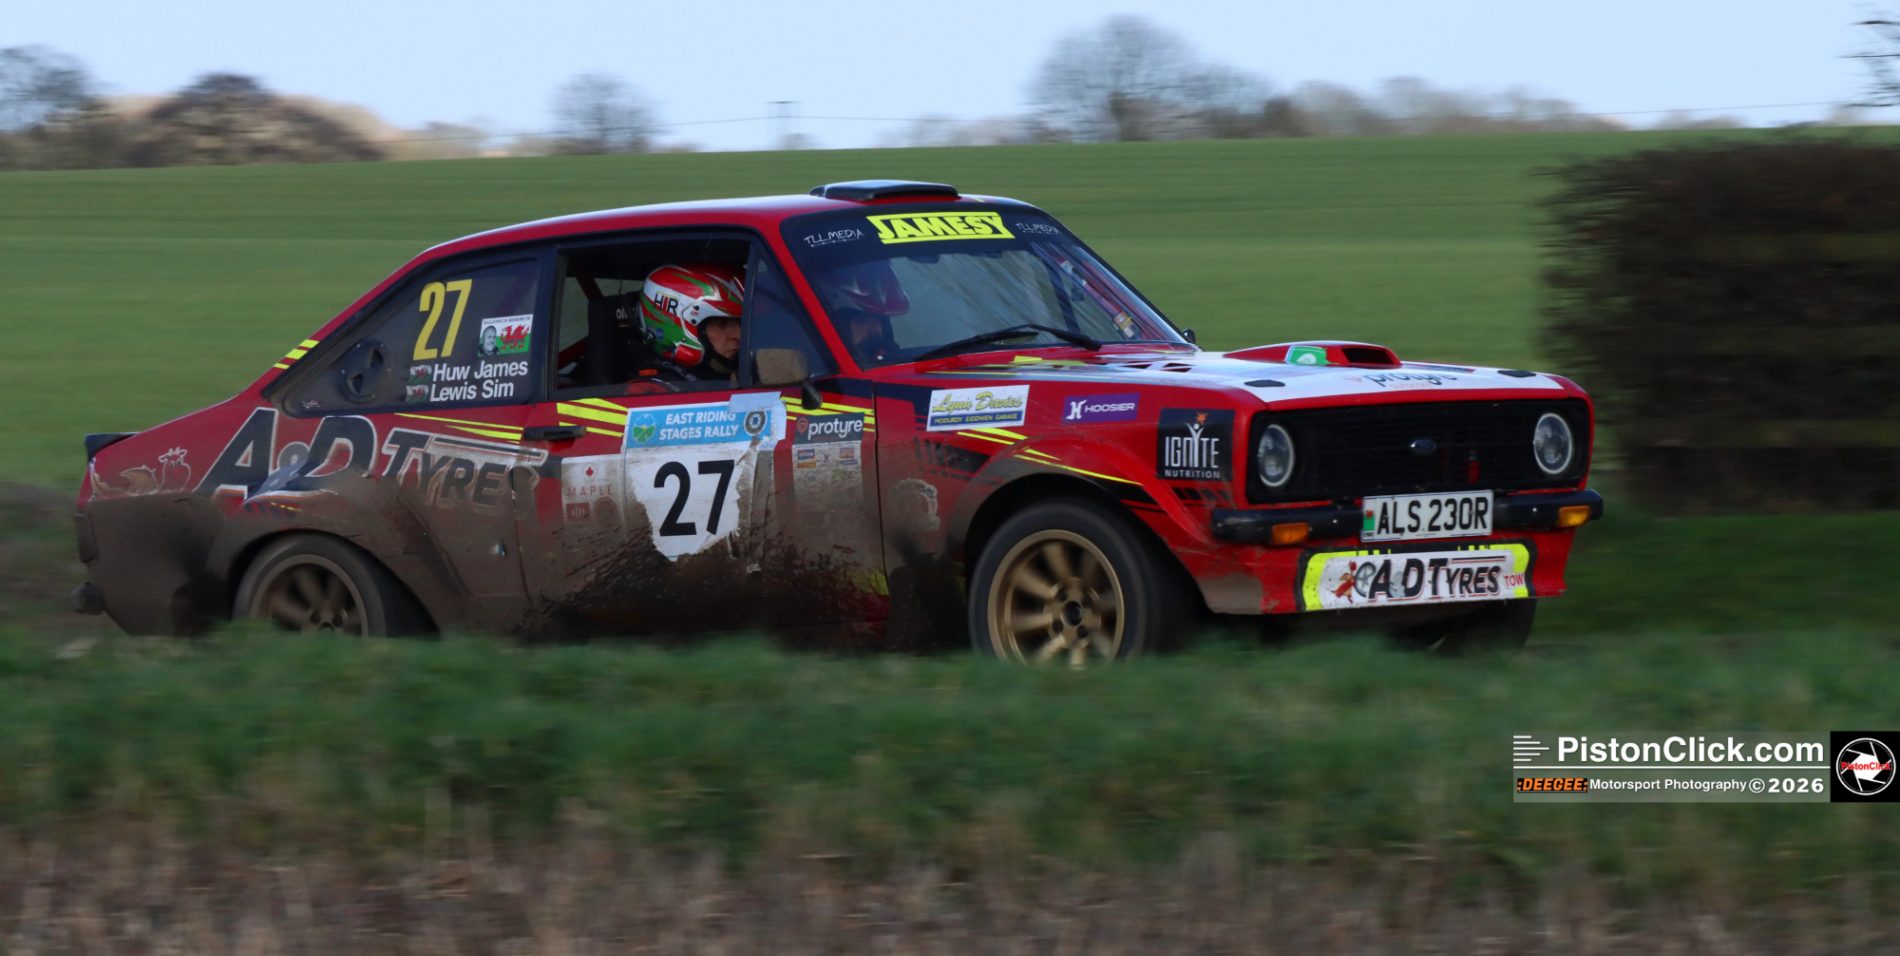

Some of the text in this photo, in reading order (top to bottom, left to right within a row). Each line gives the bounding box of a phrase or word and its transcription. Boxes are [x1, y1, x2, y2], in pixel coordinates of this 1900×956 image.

[876, 215, 1004, 240] JAMESY
[413, 279, 473, 361] 27
[433, 360, 528, 382] Huw James
[430, 379, 514, 402] Lewis Sim
[665, 410, 736, 425] EAST RIDING
[1084, 402, 1136, 413] HOOSIER
[659, 424, 739, 440] STAGES RALLY
[808, 418, 863, 440] protyre
[1165, 435, 1220, 468] IGNITE
[1164, 469, 1220, 478] NUTRITION
[567, 485, 613, 497] MAPLE
[653, 459, 735, 537] 27
[1377, 496, 1489, 535] ALS 230R
[1427, 556, 1502, 598] TYRES
[1504, 573, 1525, 587] TOW
